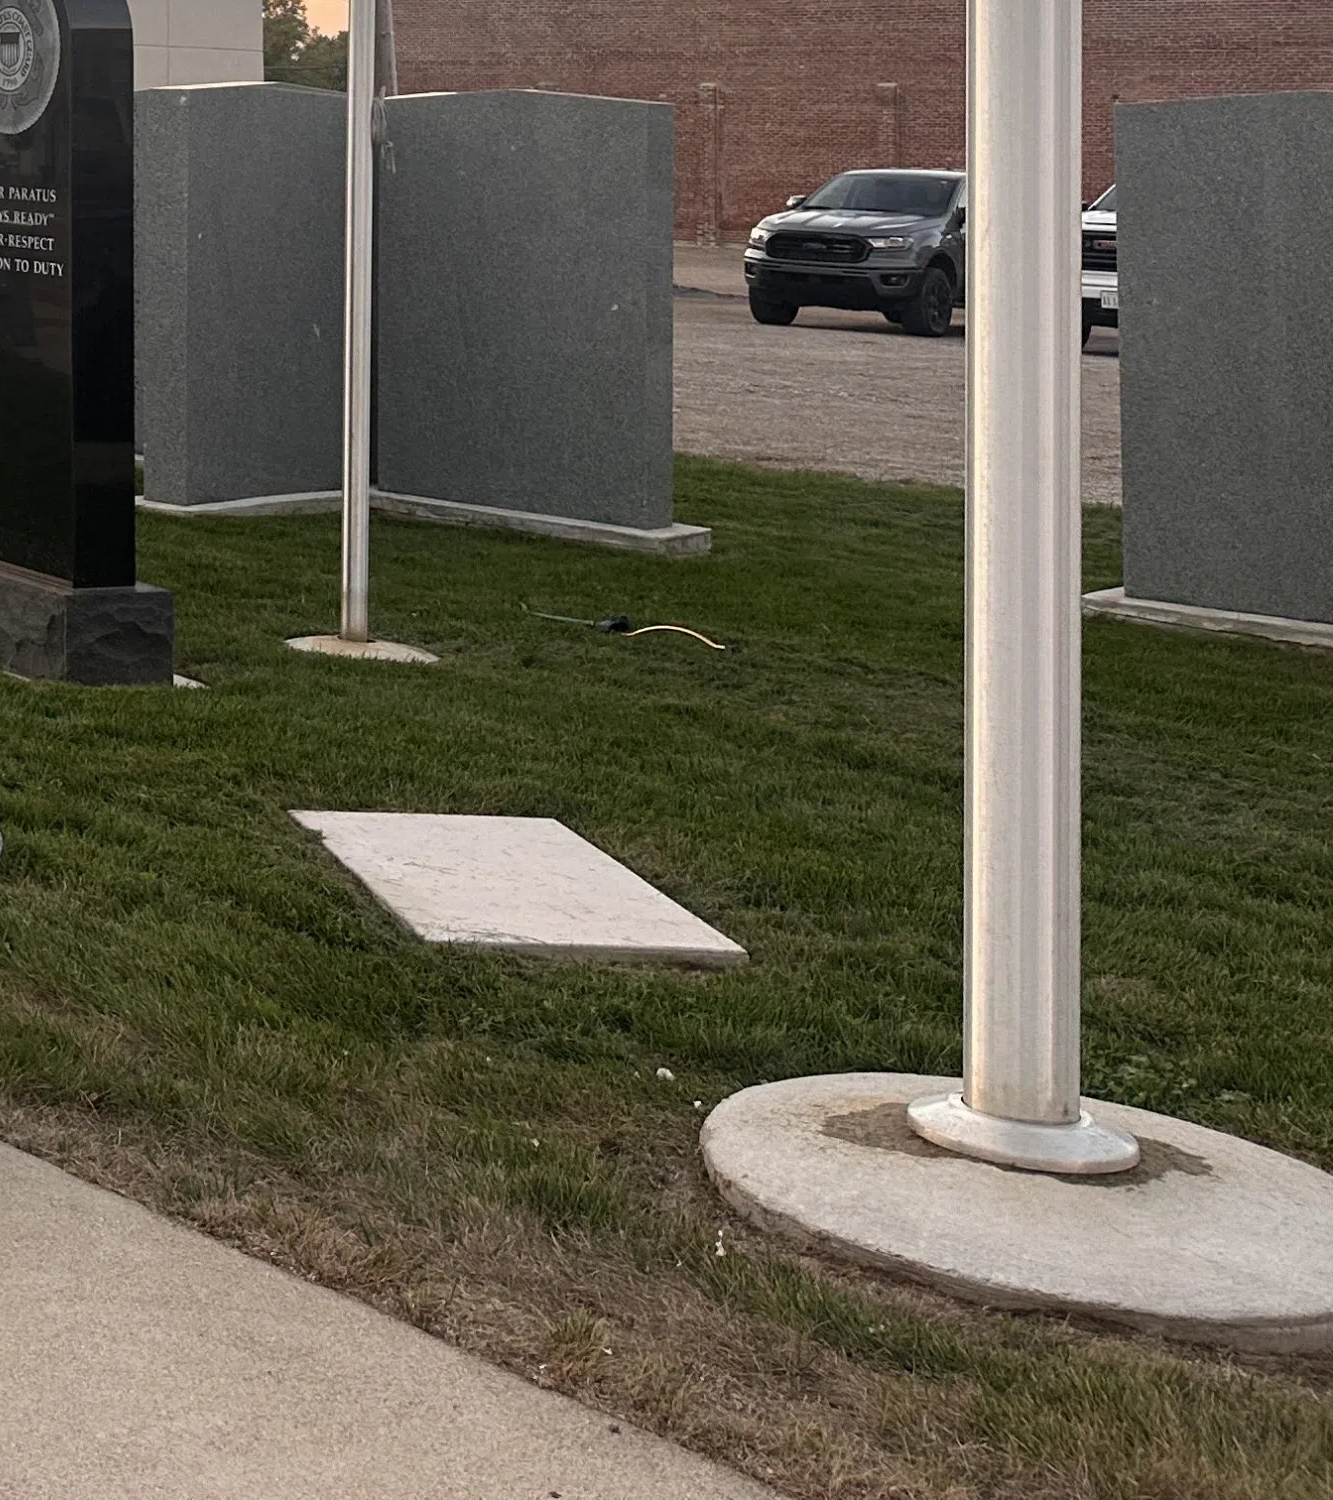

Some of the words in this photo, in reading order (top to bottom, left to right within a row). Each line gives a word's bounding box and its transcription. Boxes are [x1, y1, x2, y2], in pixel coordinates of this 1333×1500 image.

[8, 186, 57, 203] PARATUS
[13, 210, 55, 226] READY"
[14, 258, 30, 273] TO
[33, 260, 64, 277] DUTY
